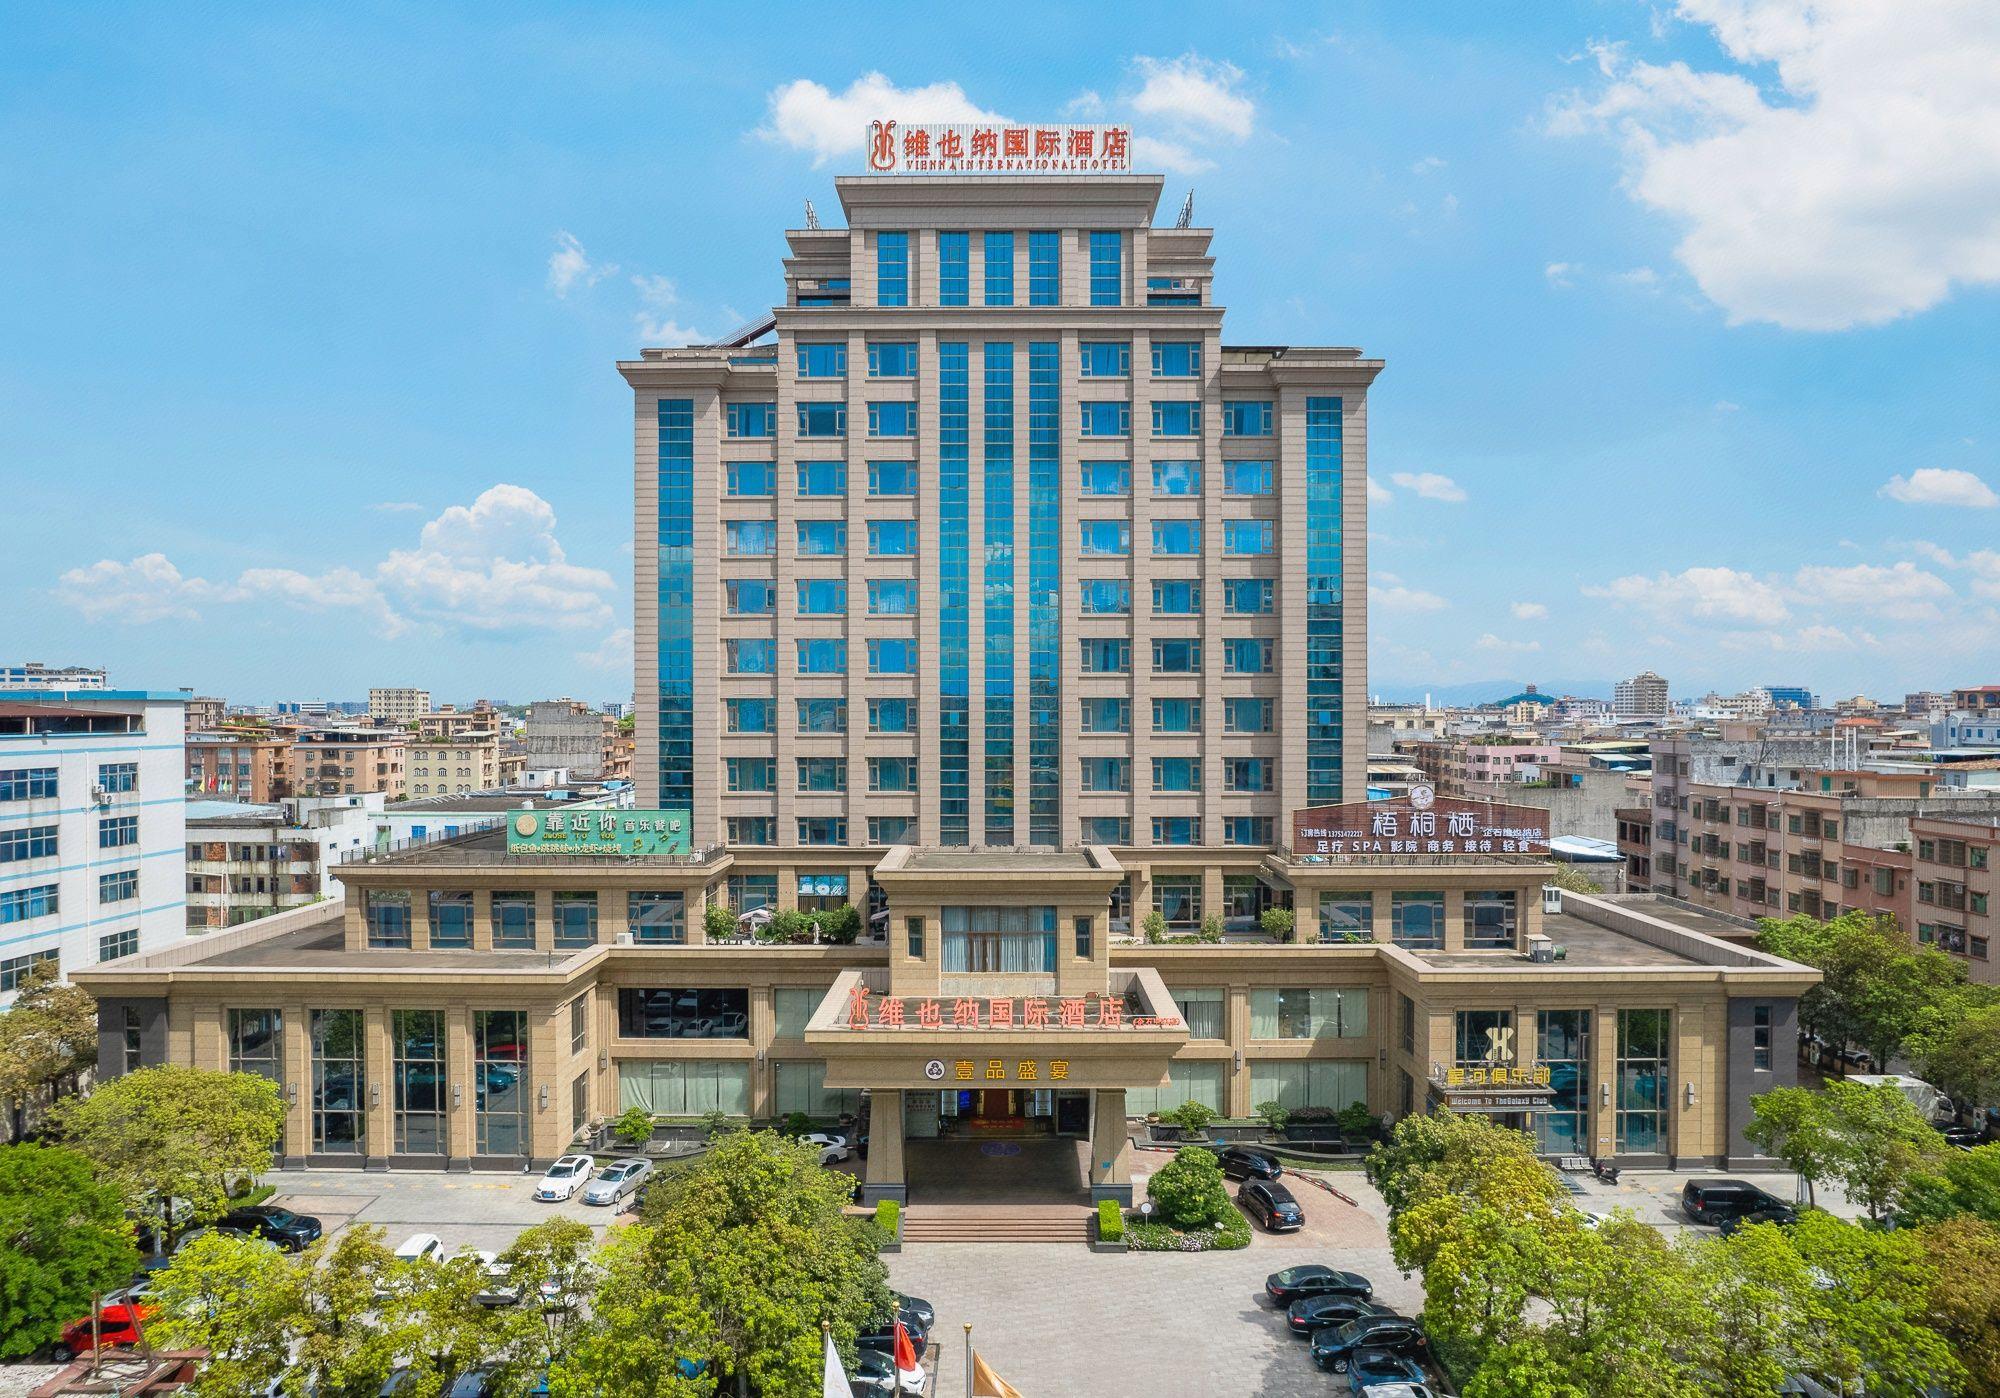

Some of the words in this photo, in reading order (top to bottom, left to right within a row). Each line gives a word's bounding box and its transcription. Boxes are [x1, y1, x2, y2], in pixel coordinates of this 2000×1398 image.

[903, 127, 1128, 158] 维也纳国际酒店
[545, 812, 617, 832] 靠近你
[624, 819, 682, 832] 音乐餐吧
[1372, 811, 1474, 837] 梧桐栖
[1317, 840, 1344, 853] 足疗
[1352, 841, 1382, 852] SPA
[1390, 840, 1418, 853] 影院
[1427, 840, 1455, 853] 商务
[1464, 840, 1492, 853] 接待
[1503, 840, 1530, 853] 轻食
[877, 996, 1125, 1027] 维也纳国际酒店
[954, 1060, 1070, 1081] 壹品盛宴
[1447, 1067, 1551, 1085] 星河俱乐部
[1451, 1097, 1481, 1105] Welcome
